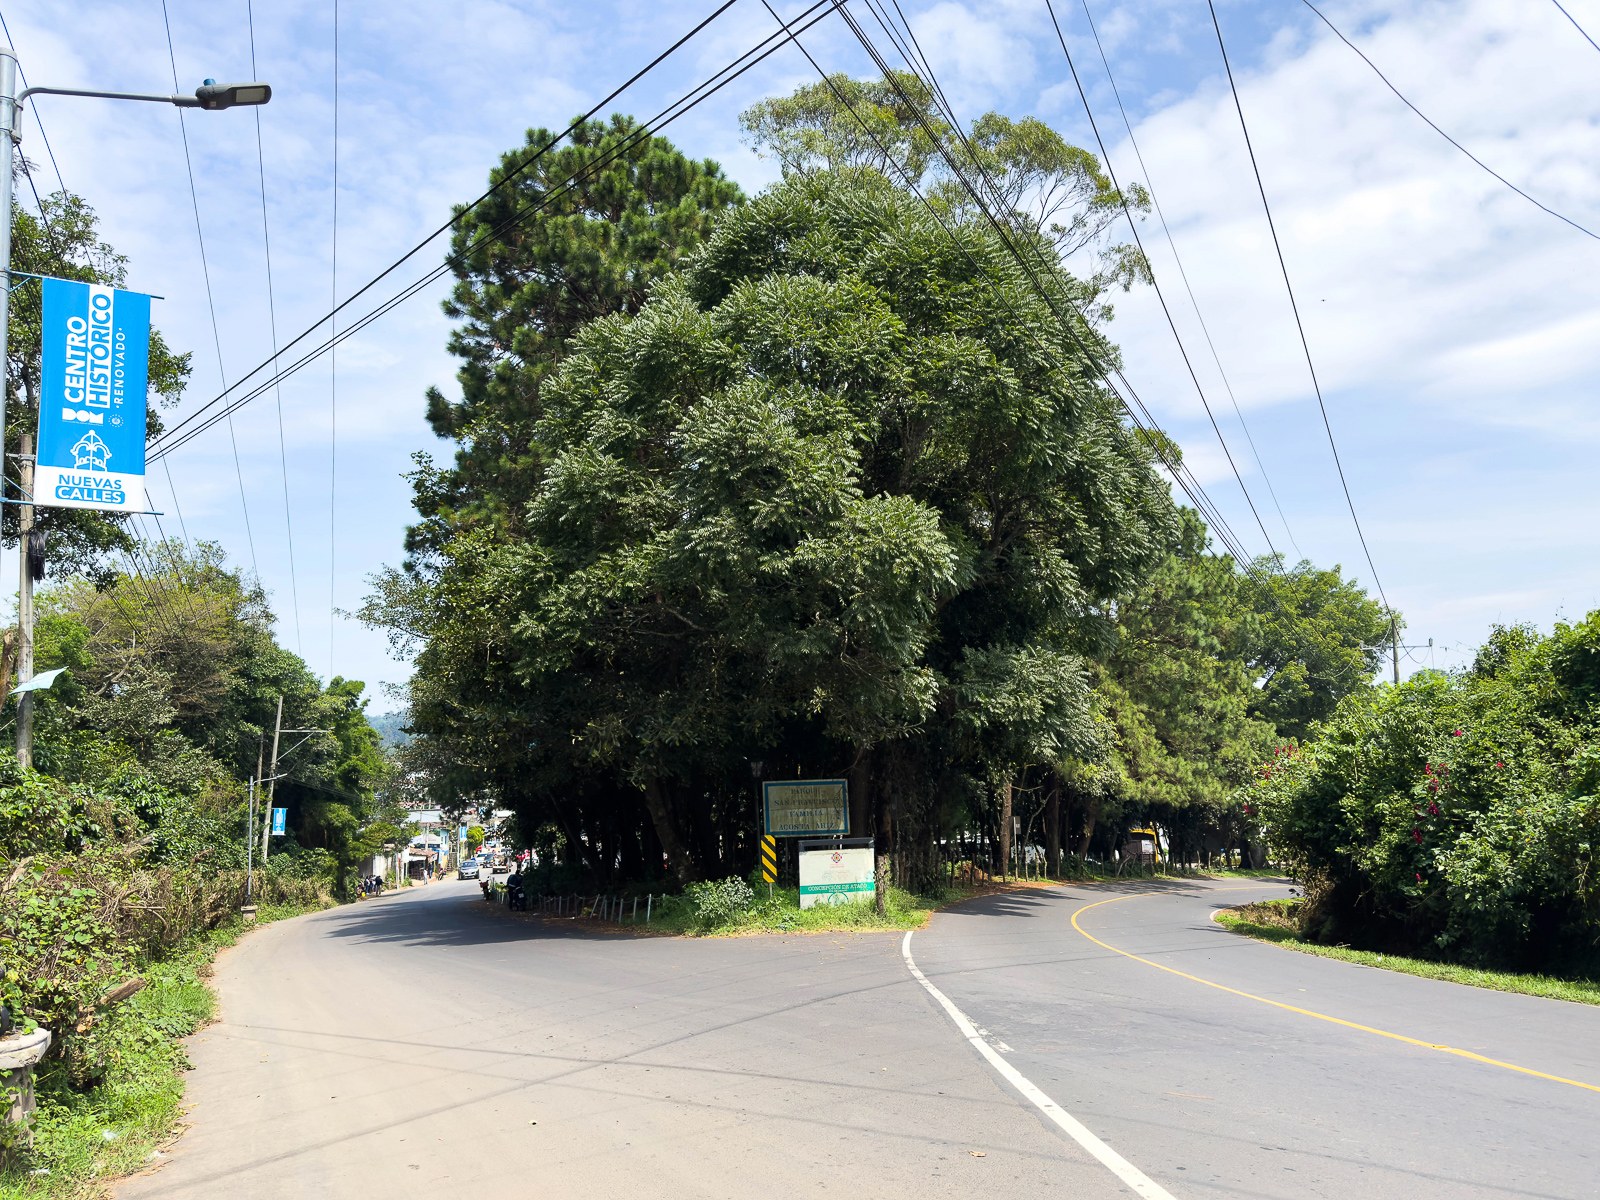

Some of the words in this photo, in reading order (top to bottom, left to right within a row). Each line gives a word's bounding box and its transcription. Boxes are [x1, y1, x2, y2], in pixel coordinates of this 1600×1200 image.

[87, 294, 111, 406] HISTÓRICO
[64, 316, 87, 403] CENTRO
[59, 474, 122, 490] NUEVAS
[58, 486, 121, 503] CALLES
[774, 799, 790, 807] SAN
[779, 823, 810, 831] ACOSTA
